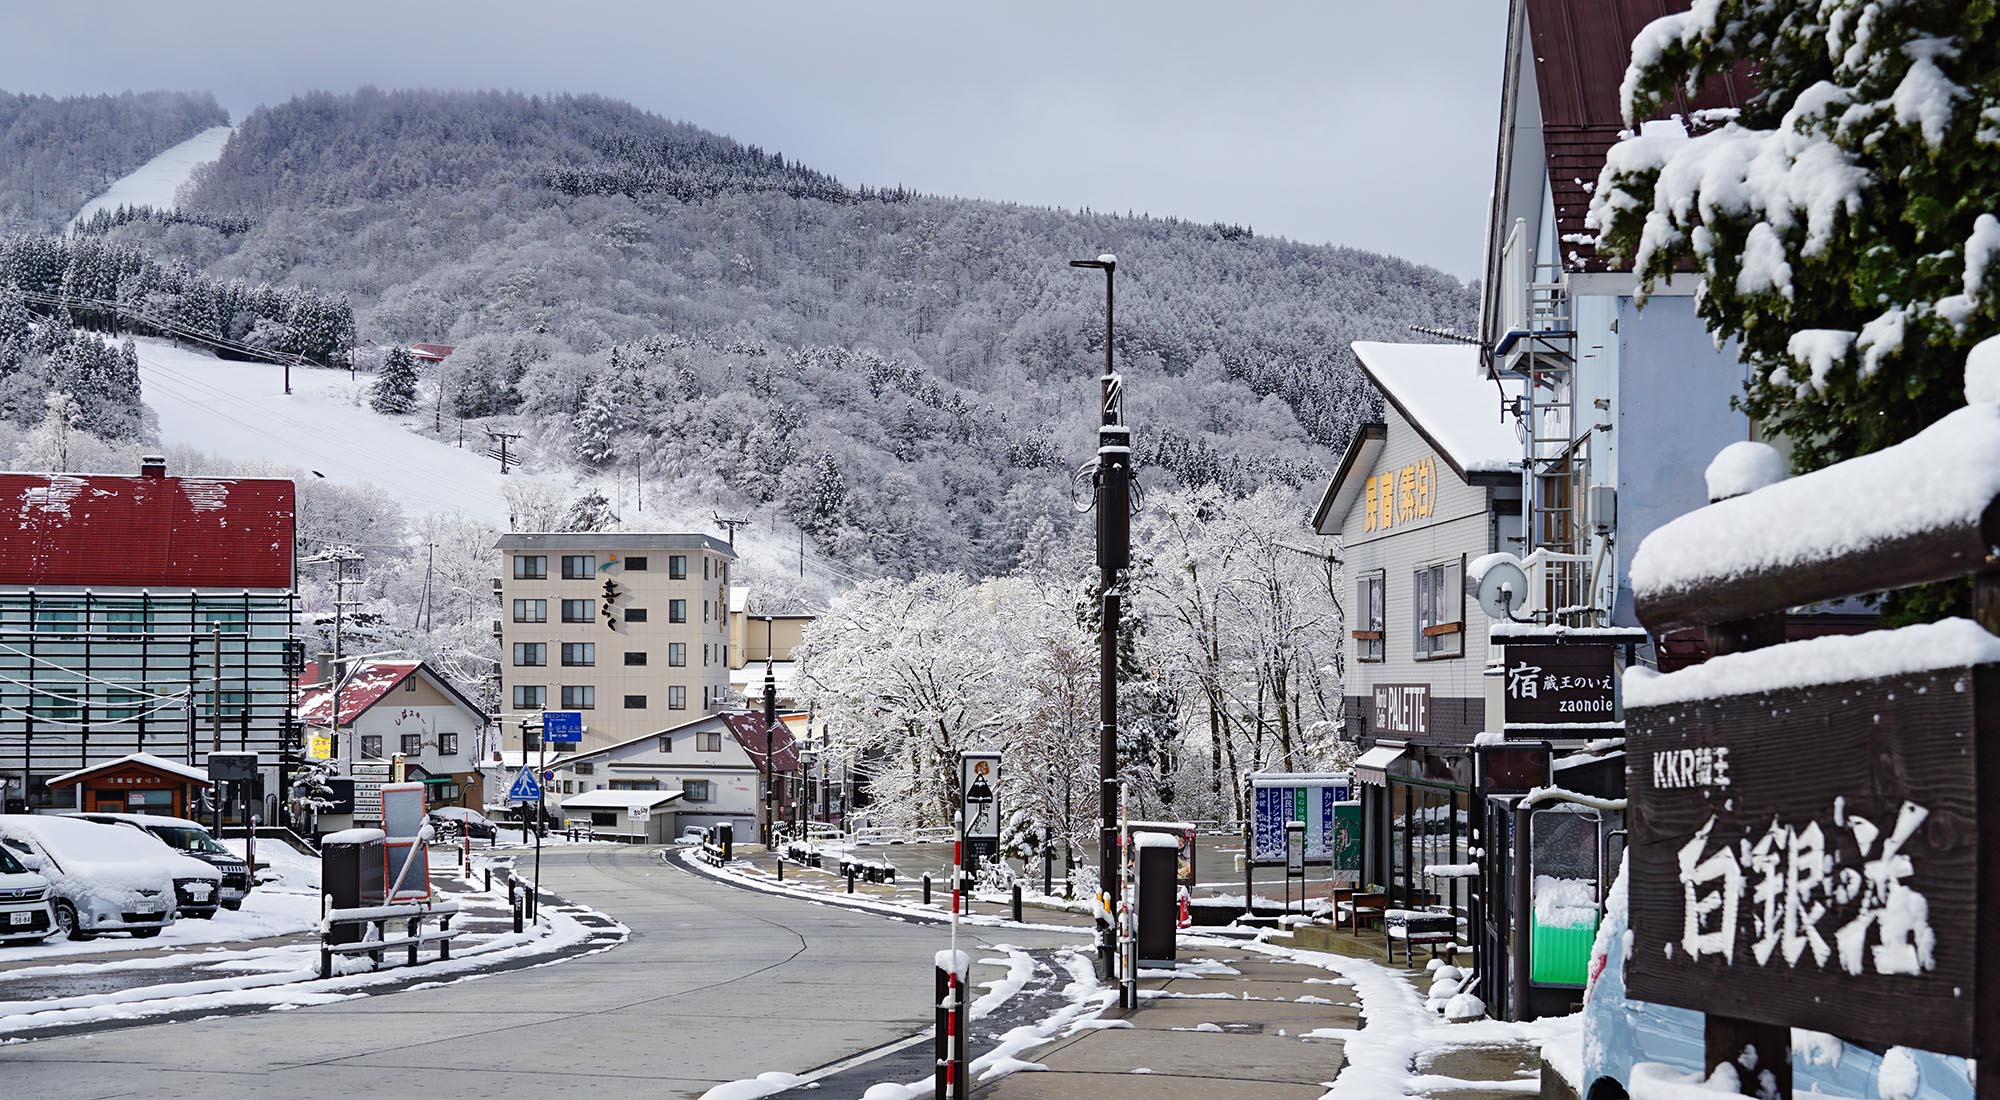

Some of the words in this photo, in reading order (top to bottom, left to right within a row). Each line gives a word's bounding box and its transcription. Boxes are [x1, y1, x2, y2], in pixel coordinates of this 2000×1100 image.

[1507, 661, 1542, 699] 宿
[1543, 674, 1613, 691] 蔵王のいえ
[1388, 686, 1426, 732] PALETTE
[1560, 696, 1613, 712] zaonoie
[1324, 791, 1332, 816] カシオ
